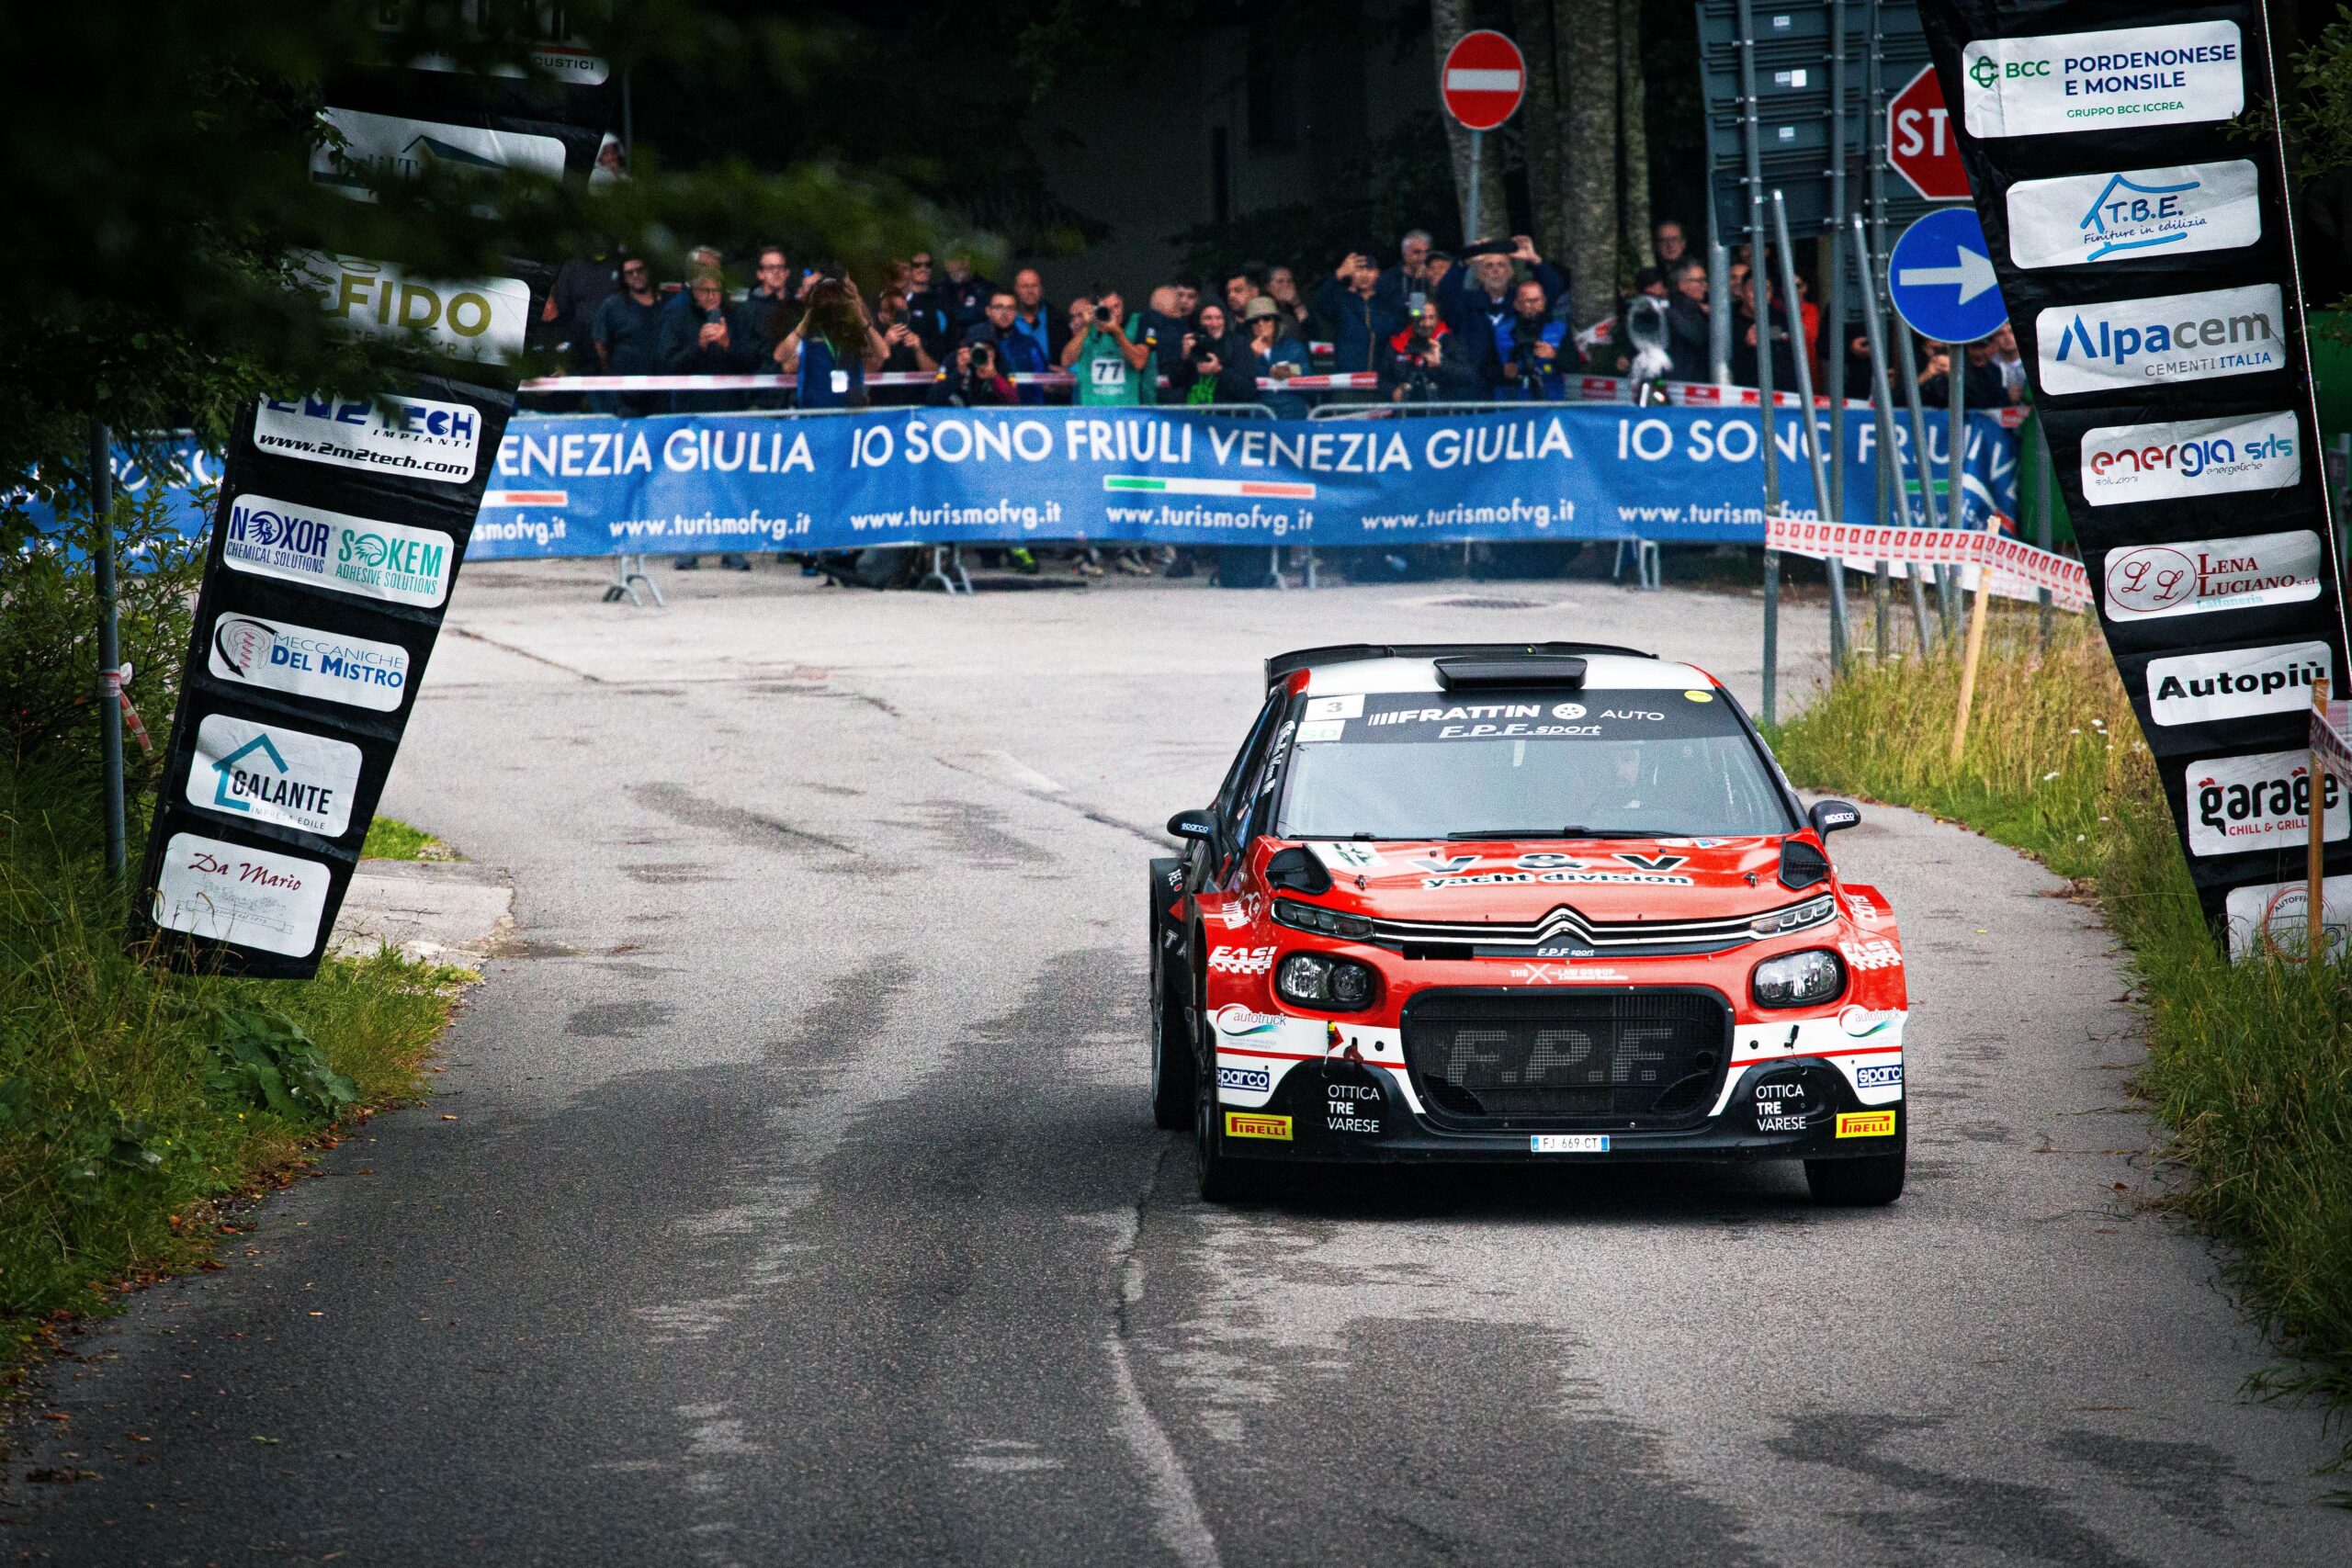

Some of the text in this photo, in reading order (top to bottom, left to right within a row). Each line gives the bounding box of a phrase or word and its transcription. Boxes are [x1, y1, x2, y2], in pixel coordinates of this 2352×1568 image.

[535, 56, 594, 72] CUSTICI
[2005, 43, 2236, 79] BCC PORDENONESE
[2064, 71, 2187, 96] E MONSILE
[2066, 100, 2185, 118] GRUPPO BCC ICCREA
[1896, 107, 1948, 157] ST
[2104, 195, 2184, 224] T.B.E.
[2083, 217, 2208, 244] Finiture in edilizia
[2055, 311, 2271, 366] Alpacem
[1095, 361, 1123, 380] 77
[2144, 351, 2273, 378] CEMENTI ITALIA
[372, 429, 470, 449] IMPIANTI
[850, 417, 1574, 473] IO SONO FRIULI VENEZIA GIULIA
[1617, 419, 1673, 460] IO
[2244, 433, 2294, 460] srls
[259, 434, 469, 476] www.2m2tech.com
[497, 428, 816, 477] ENEZIA GIULIA
[850, 499, 1062, 531] www.turismofvg.it
[1106, 503, 1314, 536] www.turismofvg.it
[1362, 497, 1576, 529] www.turismofvg.it
[609, 509, 812, 542] www.turismofvg.it
[226, 541, 271, 564] CHEMICAL
[274, 549, 325, 574] SOLUTIONS
[2197, 553, 2259, 576] LENA
[335, 562, 438, 596] ADHESIVE SOLUTIONS
[2197, 574, 2296, 597] LUCIANO
[273, 632, 405, 670] MECCANICHE
[271, 644, 403, 688] DEL MISTRO
[2156, 660, 2325, 701] Autopiù
[1396, 705, 1665, 724] FRATTIN AUTO
[232, 770, 334, 816] GALANTE
[297, 817, 325, 830] EDILE
[2229, 818, 2308, 836] CHILL & GRILL
[187, 852, 302, 891] Da Mario
[1408, 855, 1481, 874] V
[1611, 853, 1690, 873] V
[1423, 872, 1690, 888] yacht division
[1570, 948, 1596, 957] sport
[1233, 1011, 1287, 1026] autotruck
[1854, 1008, 1902, 1022] autotruck
[1328, 1084, 1381, 1100] OTTICA
[1755, 1084, 1804, 1100] OTTICA
[1328, 1100, 1355, 1115] TRE
[1756, 1101, 1782, 1115] TRE
[1230, 1116, 1286, 1136] PIRELLI
[1327, 1117, 1380, 1134] VARESE
[1756, 1117, 1807, 1132] VARESE
[1841, 1115, 1891, 1134] PIRELLI
[1542, 1138, 1599, 1149] FJ 669 CT
